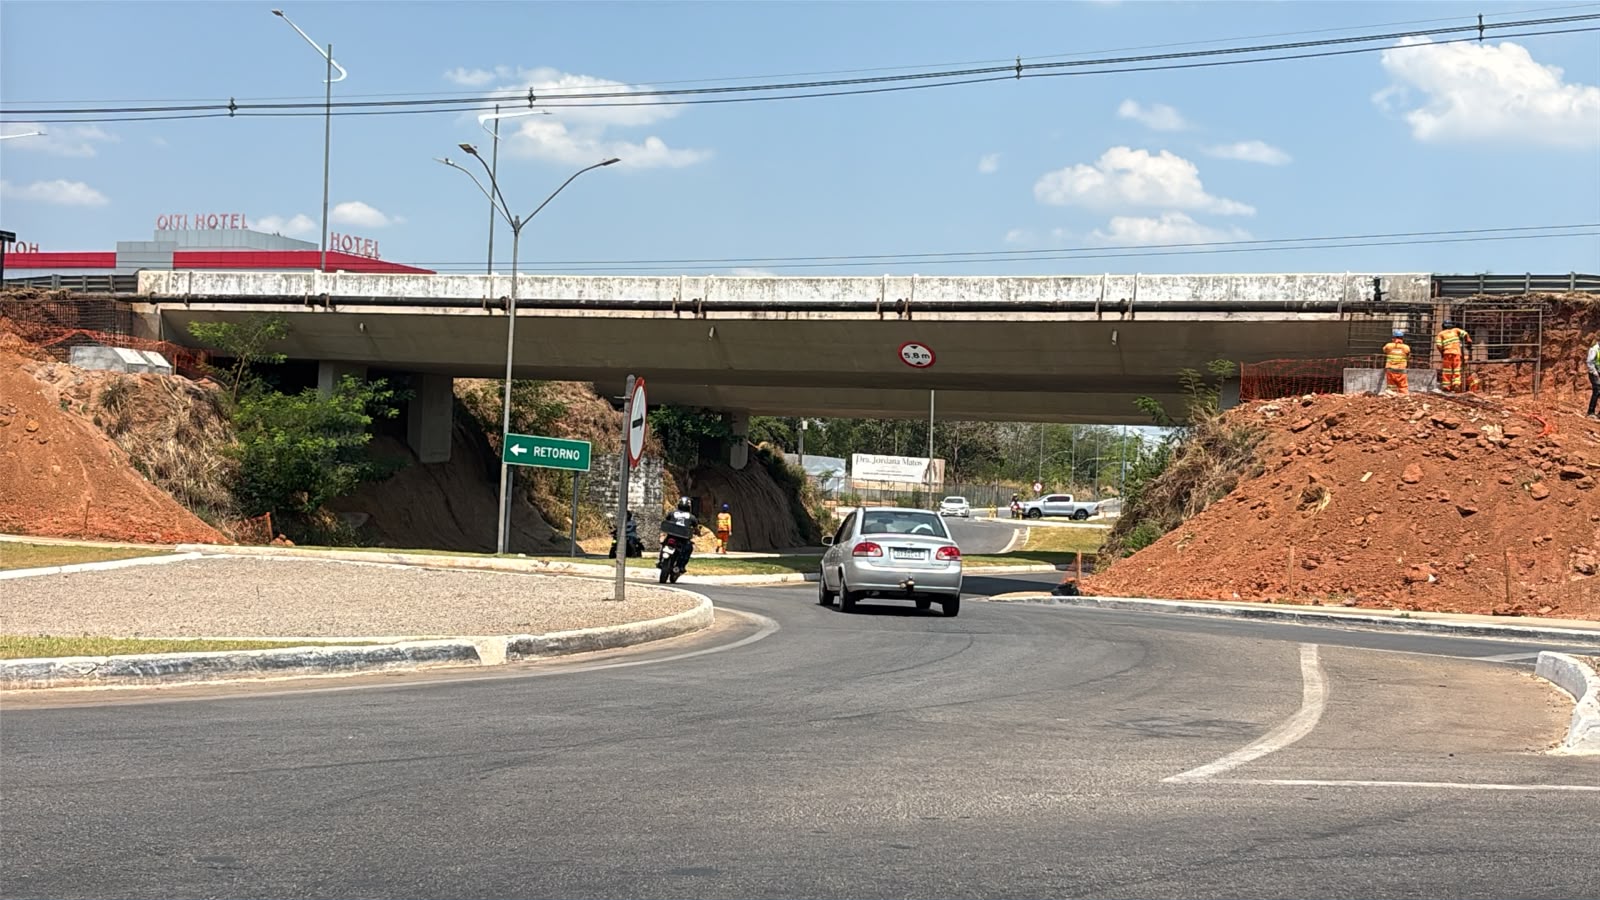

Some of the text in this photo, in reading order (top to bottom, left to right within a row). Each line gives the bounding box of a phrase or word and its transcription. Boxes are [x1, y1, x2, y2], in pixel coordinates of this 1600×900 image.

[194, 213, 249, 230] HOTEL
[330, 231, 381, 258] HOTEL
[533, 446, 580, 461] RETORNO
[902, 457, 922, 466] Matos
